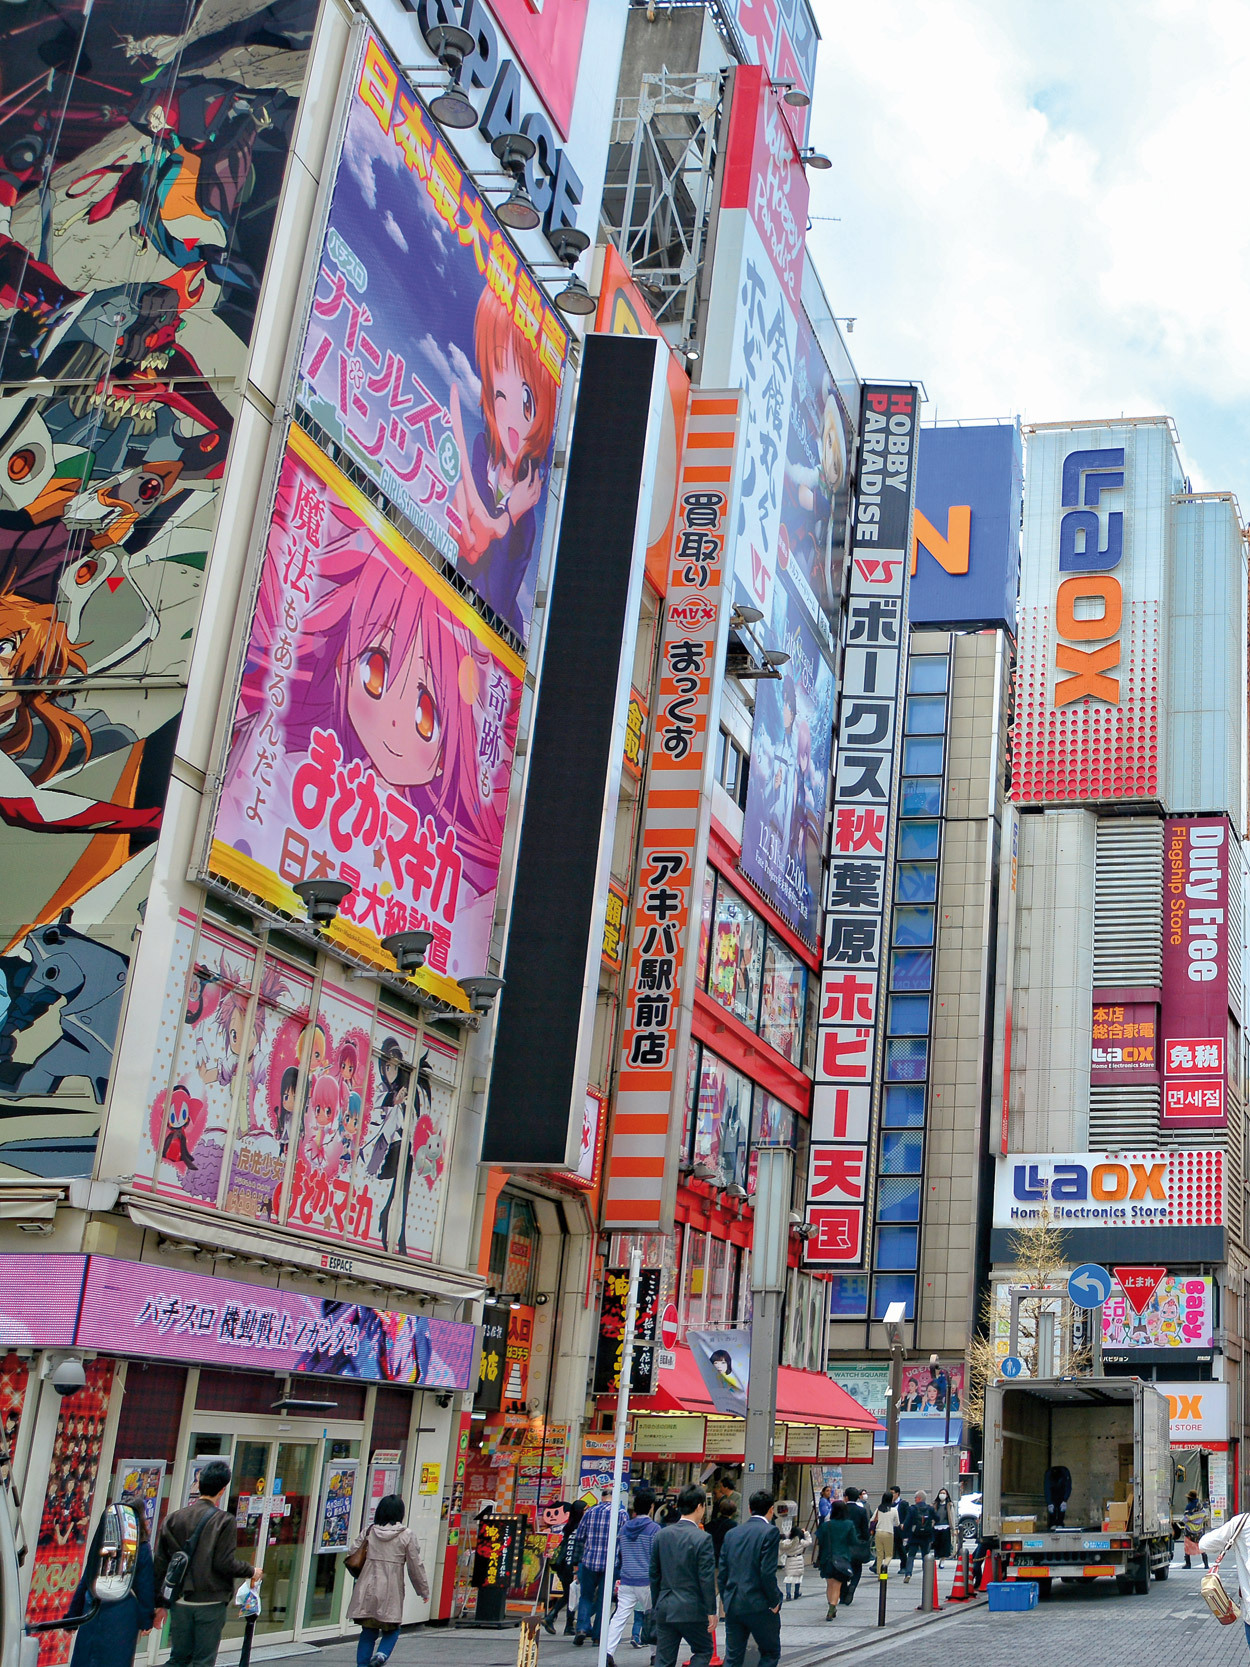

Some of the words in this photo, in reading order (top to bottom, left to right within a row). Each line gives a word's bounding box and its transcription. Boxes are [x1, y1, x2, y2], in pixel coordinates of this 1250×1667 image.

[359, 36, 568, 388] 日本最大級設置
[857, 393, 887, 542] PARADISE
[886, 393, 911, 494] HOBBY
[678, 491, 725, 588] 買取り
[246, 483, 326, 826] 魔法もあるんだよ
[664, 641, 707, 759] まっくす
[480, 671, 512, 801] 奇跡も
[1168, 826, 1186, 895] Flagship
[1186, 825, 1224, 901] Duty
[1169, 897, 1186, 946] Store
[1187, 907, 1224, 982] Free
[630, 854, 684, 1066] アキバ駅前店
[1092, 1023, 1155, 1039] 総合家電
[1093, 1007, 1124, 1022] 本店
[1169, 1044, 1219, 1069] 免税
[1168, 1088, 1220, 1108] 면세점
[1131, 1204, 1168, 1218] Store
[329, 1257, 352, 1272] ESPACE
[1124, 1276, 1155, 1287] 止まれ
[140, 1296, 216, 1336] パチスロ
[220, 1302, 294, 1350] 機動戦士
[509, 1316, 531, 1342] 入口
[507, 1345, 529, 1361] はコチラ
[31, 1562, 80, 1594] AKB48
